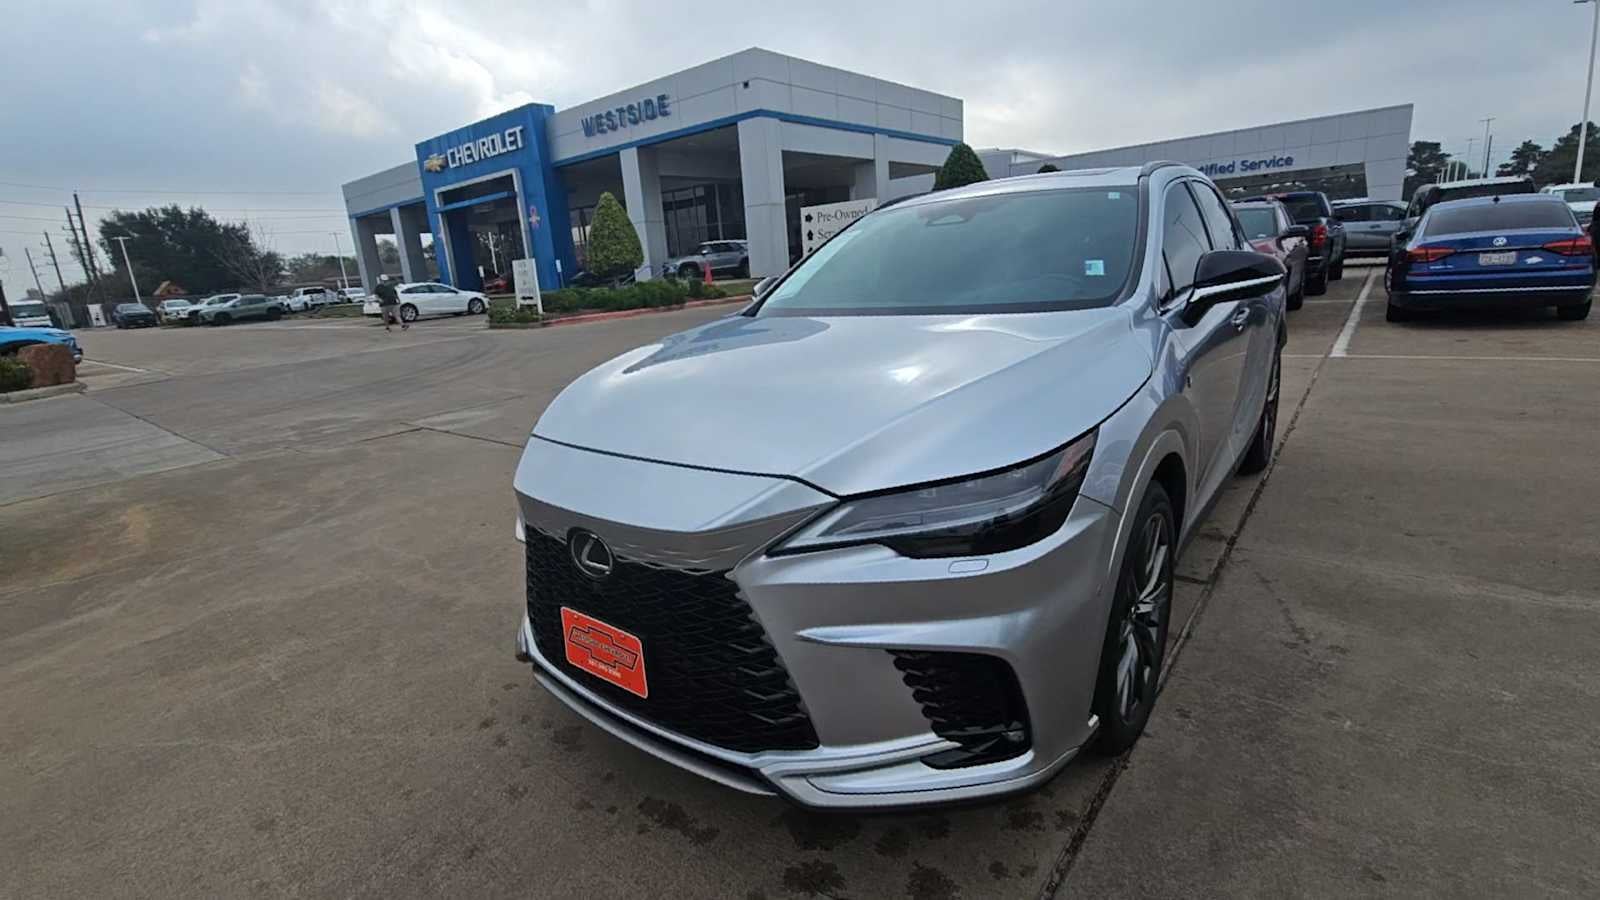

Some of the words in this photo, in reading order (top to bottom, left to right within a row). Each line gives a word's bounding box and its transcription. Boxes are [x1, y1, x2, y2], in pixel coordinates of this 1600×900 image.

[581, 94, 672, 138] WESTSIDE
[447, 126, 523, 168] CHEVROLET
[1197, 160, 1236, 175] ified
[1240, 156, 1294, 172] Service
